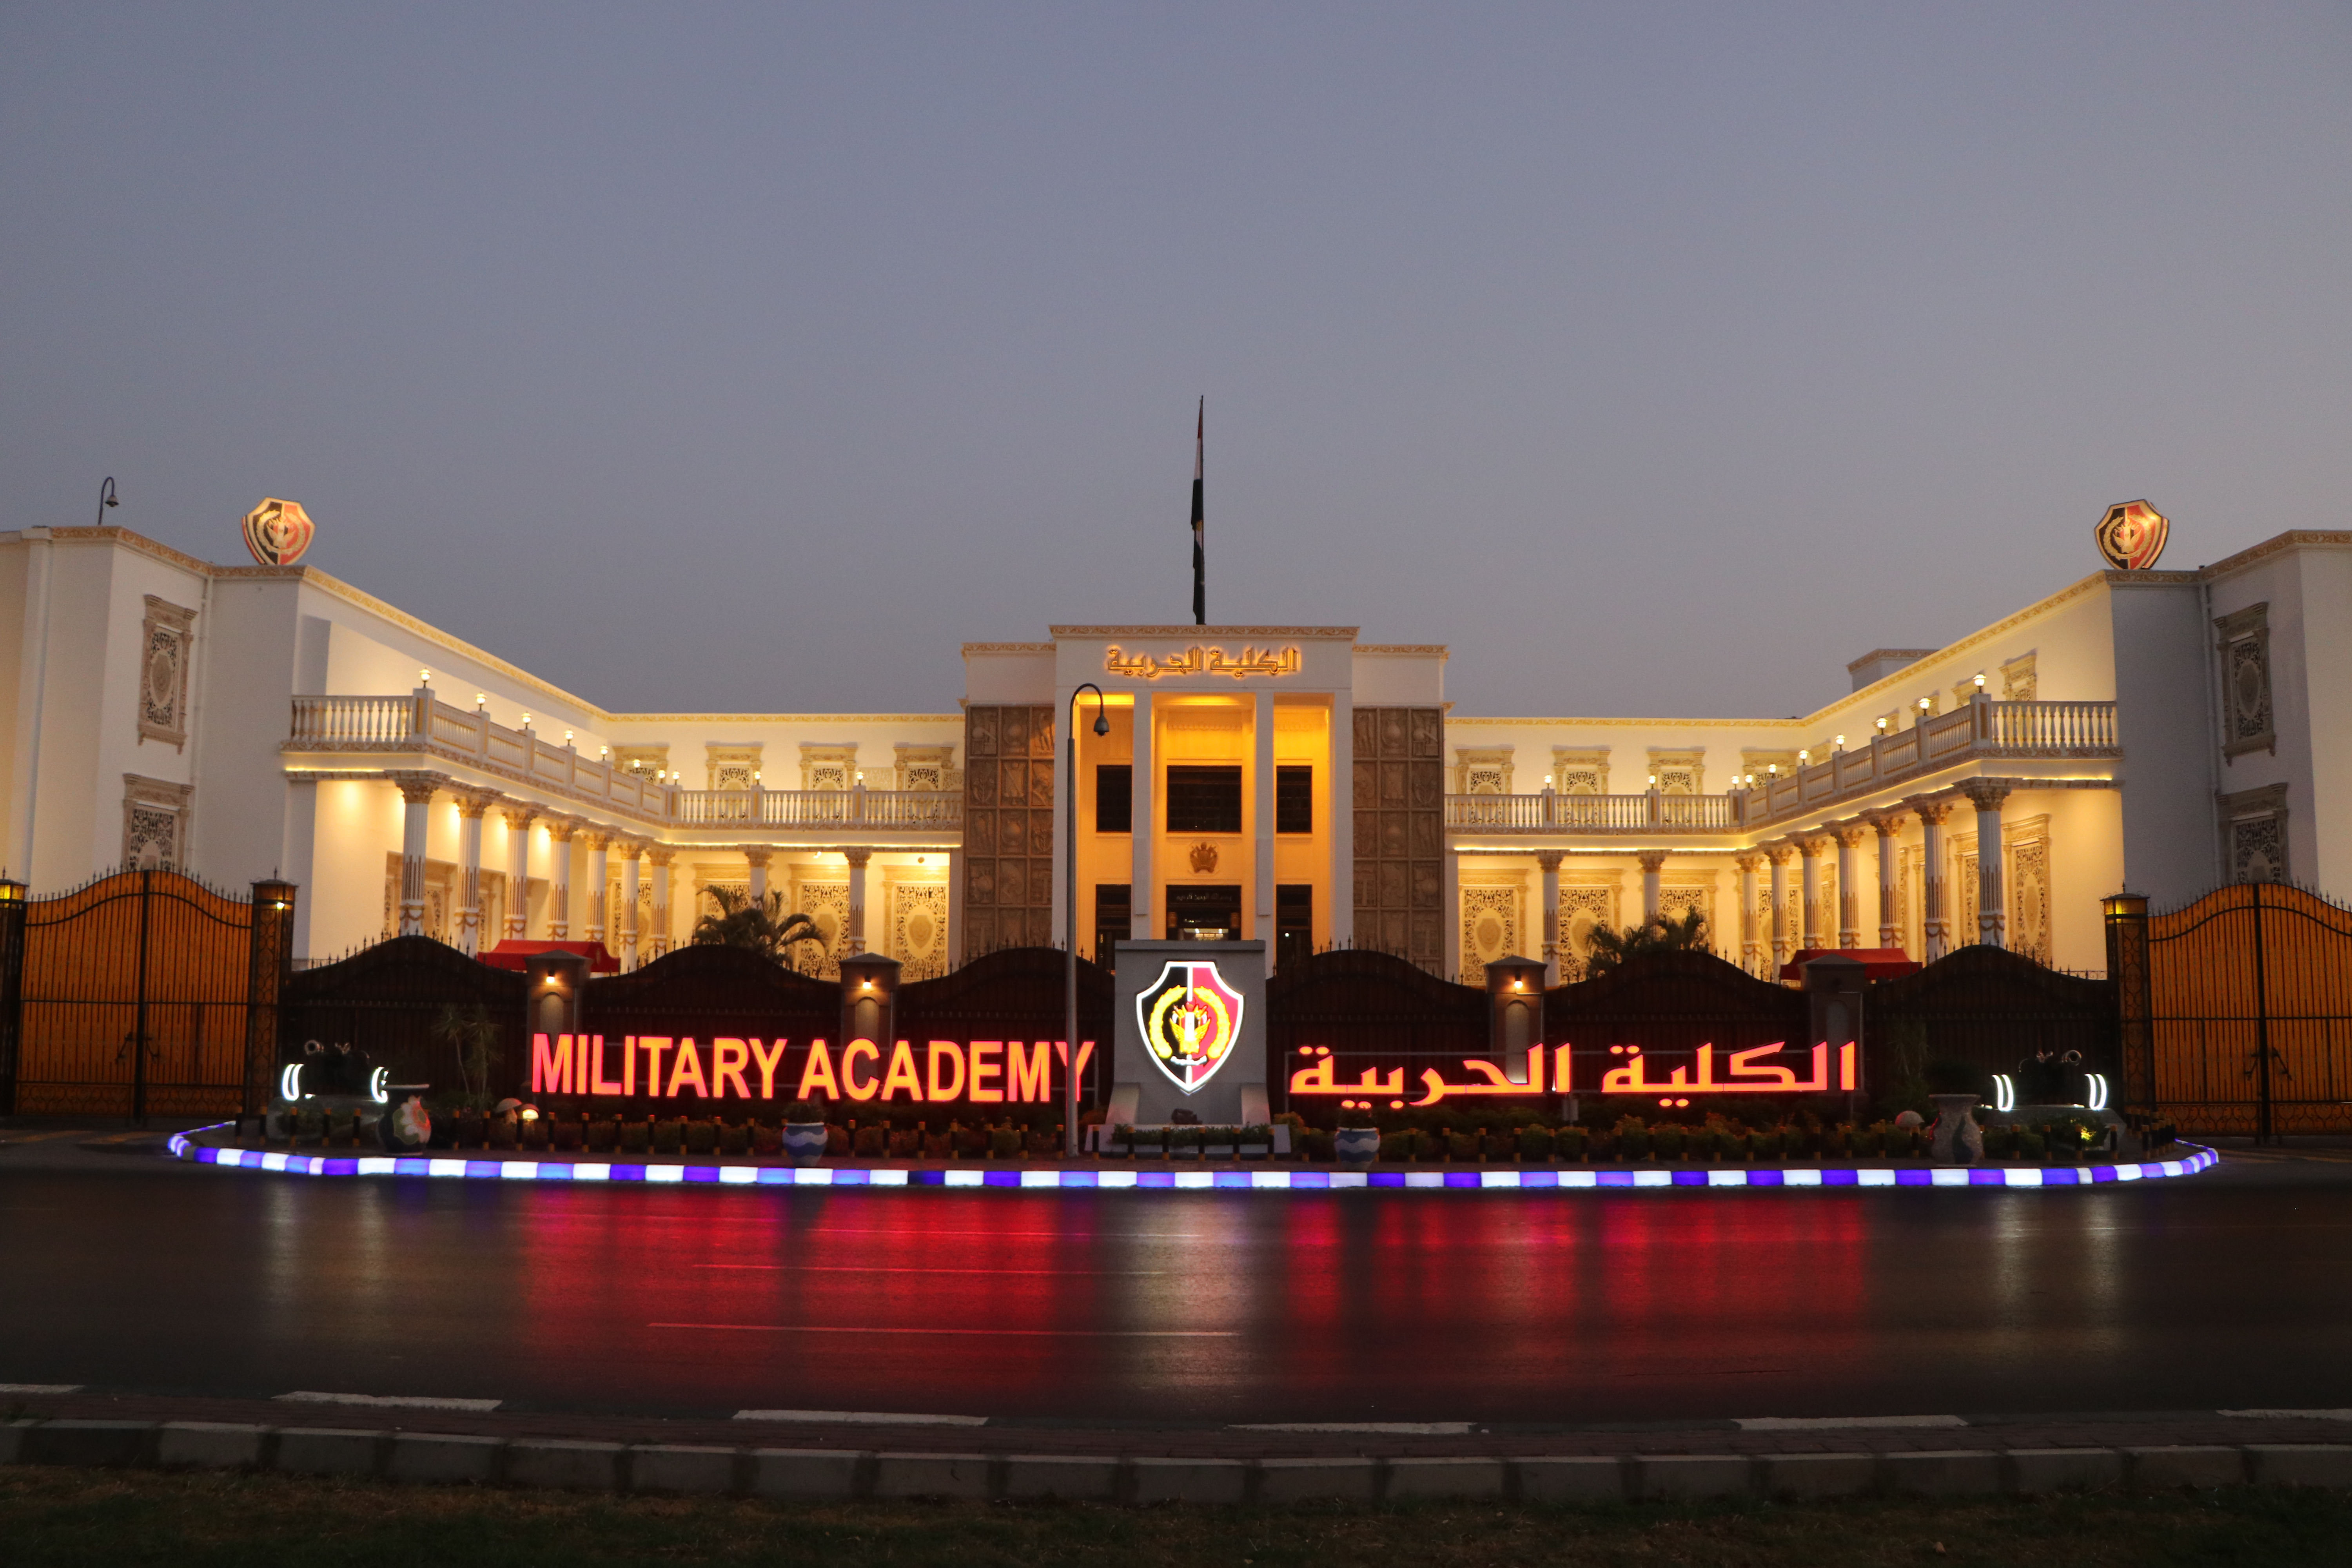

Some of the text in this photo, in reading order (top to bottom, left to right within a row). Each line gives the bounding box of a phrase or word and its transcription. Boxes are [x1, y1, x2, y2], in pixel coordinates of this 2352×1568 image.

[1108, 646, 1299, 677] الكلية الحربية
[532, 1033, 1095, 1102] MILITARY ACADEMY
[1289, 1041, 1855, 1109] الكلية الحربية
